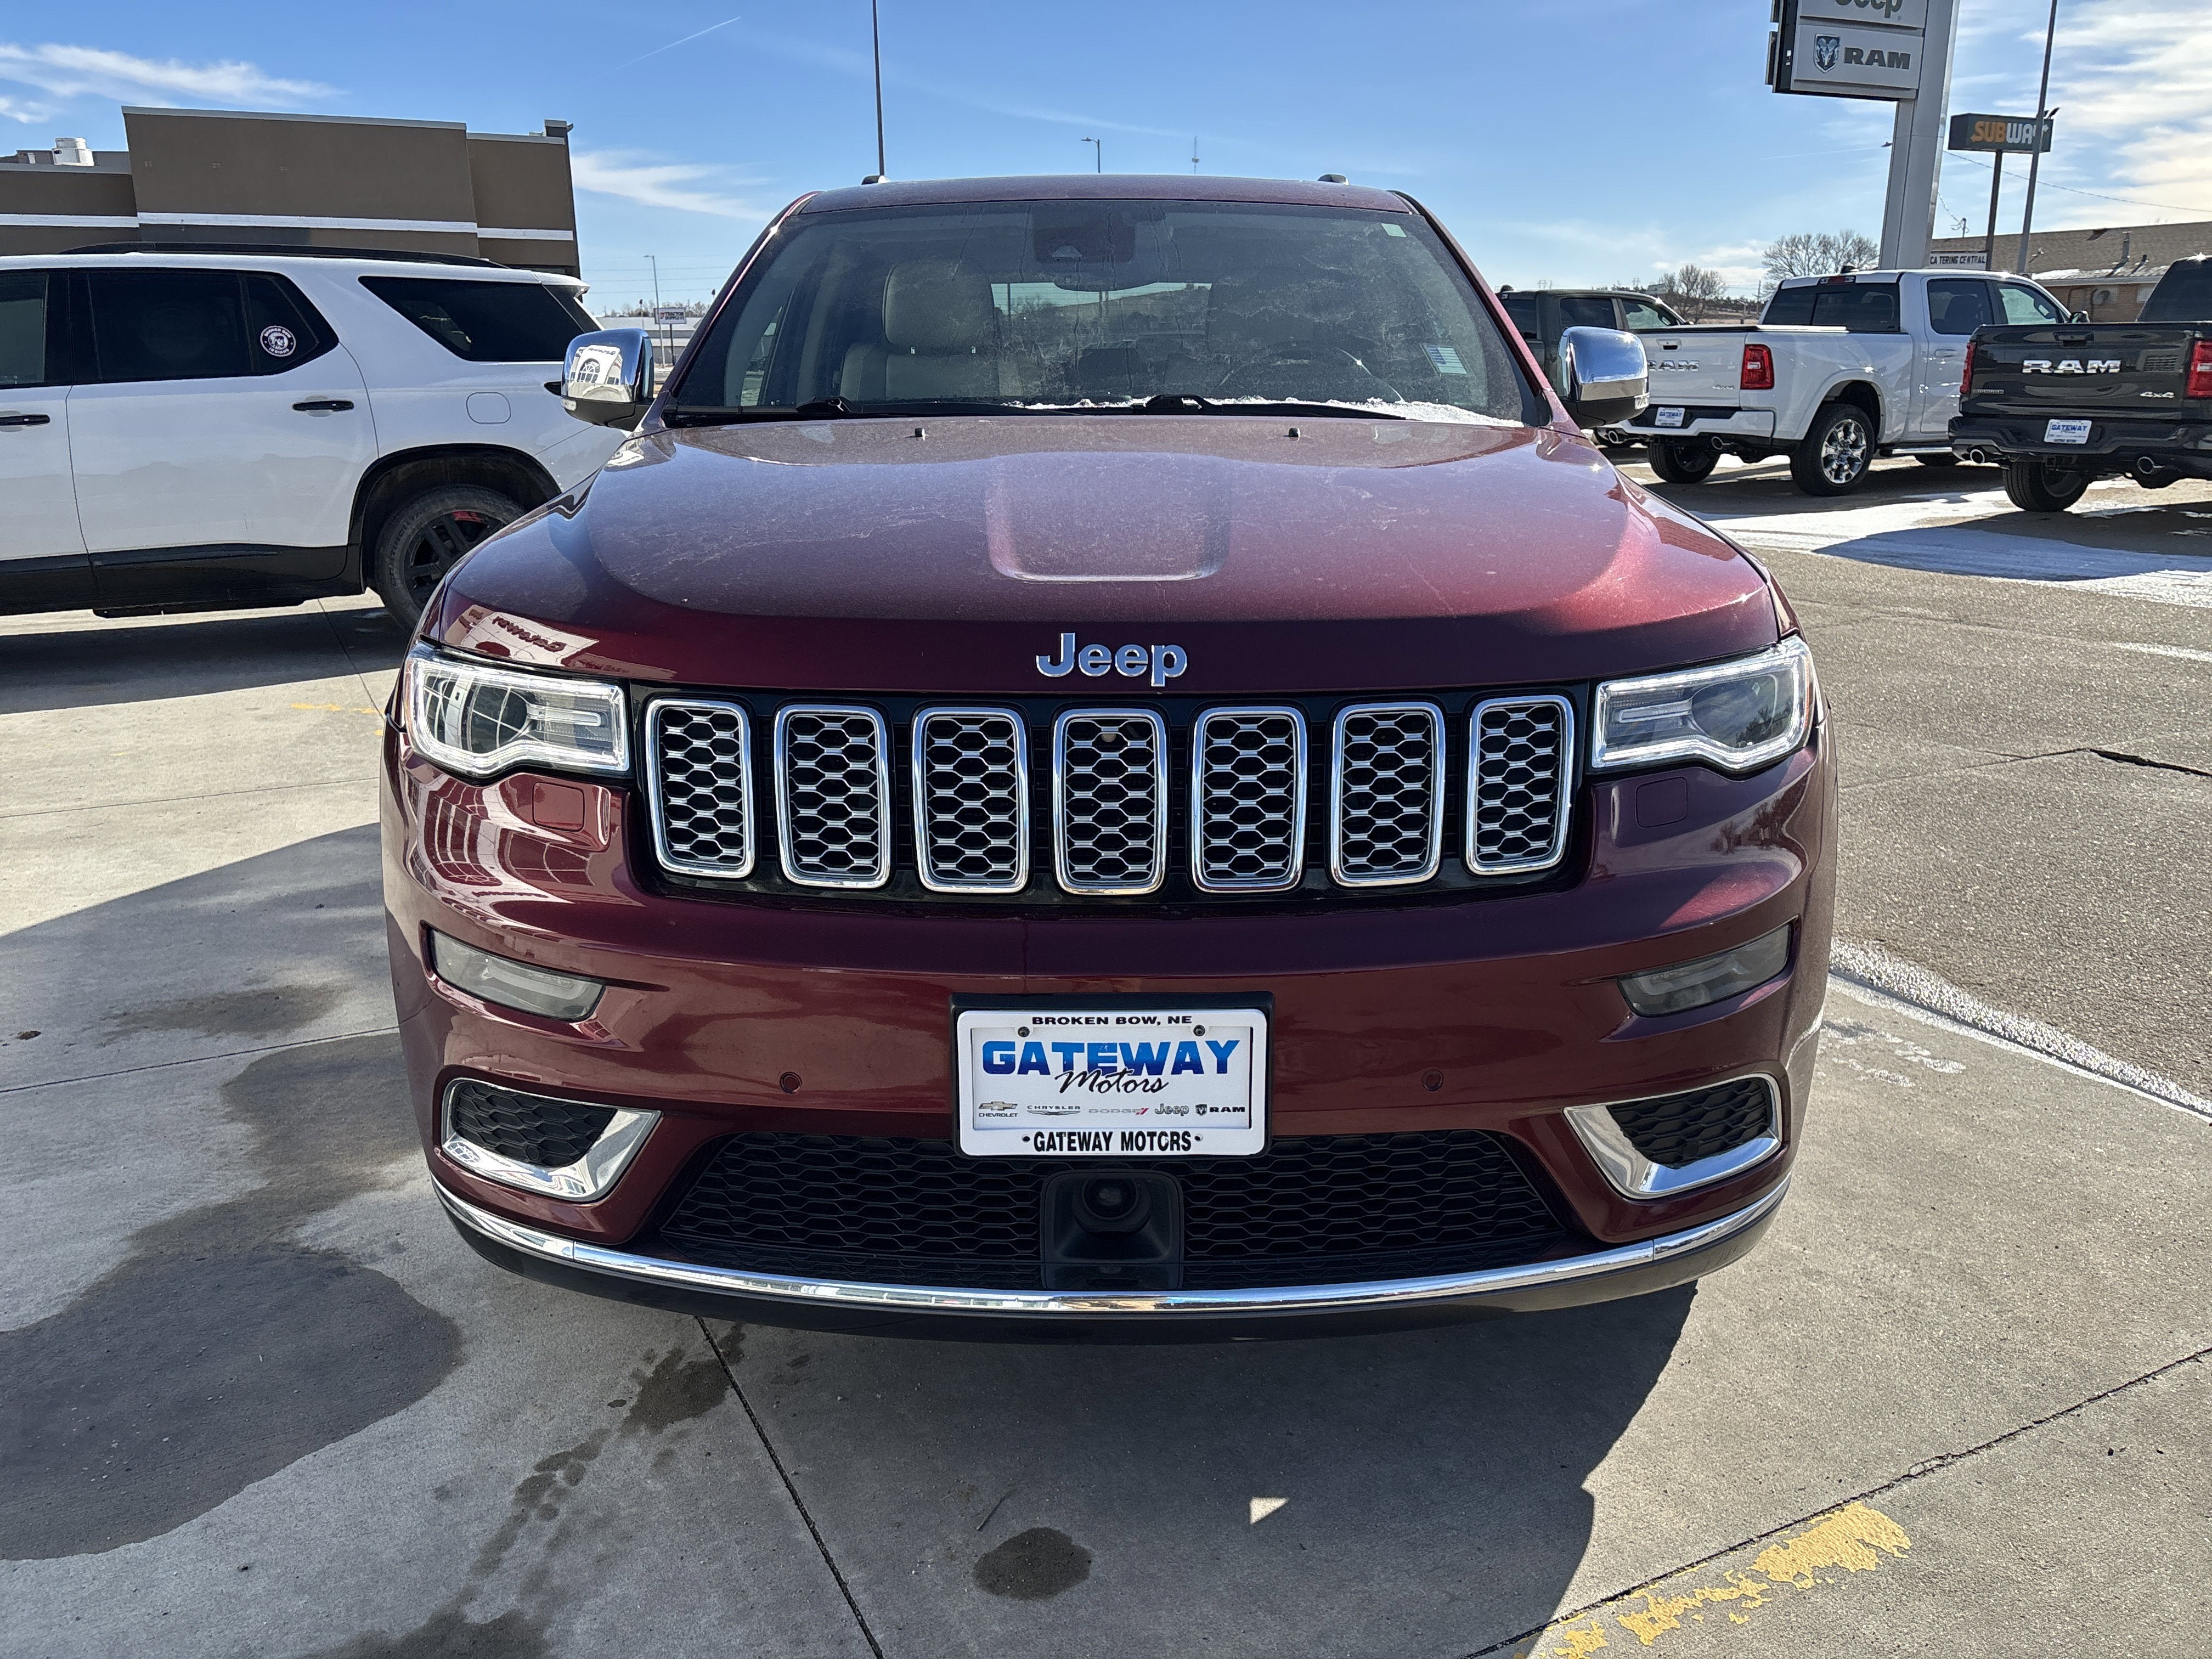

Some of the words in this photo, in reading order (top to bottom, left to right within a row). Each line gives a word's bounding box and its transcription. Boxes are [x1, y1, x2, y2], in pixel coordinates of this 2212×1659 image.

[1843, 47, 1911, 70] RAM
[2022, 360, 2121, 374] RAM
[1036, 633, 1188, 687] Jeep
[1032, 1016, 1109, 1025] BROKEN
[1115, 1015, 1161, 1026] BOW,
[1168, 1015, 1192, 1024] NE
[982, 1040, 1240, 1076] GATEWAY
[1054, 1067, 1170, 1093] Motors
[1154, 1103, 1189, 1116] Jeep
[1034, 1132, 1113, 1152] GATEWAY
[1120, 1131, 1192, 1152] MOTORS
